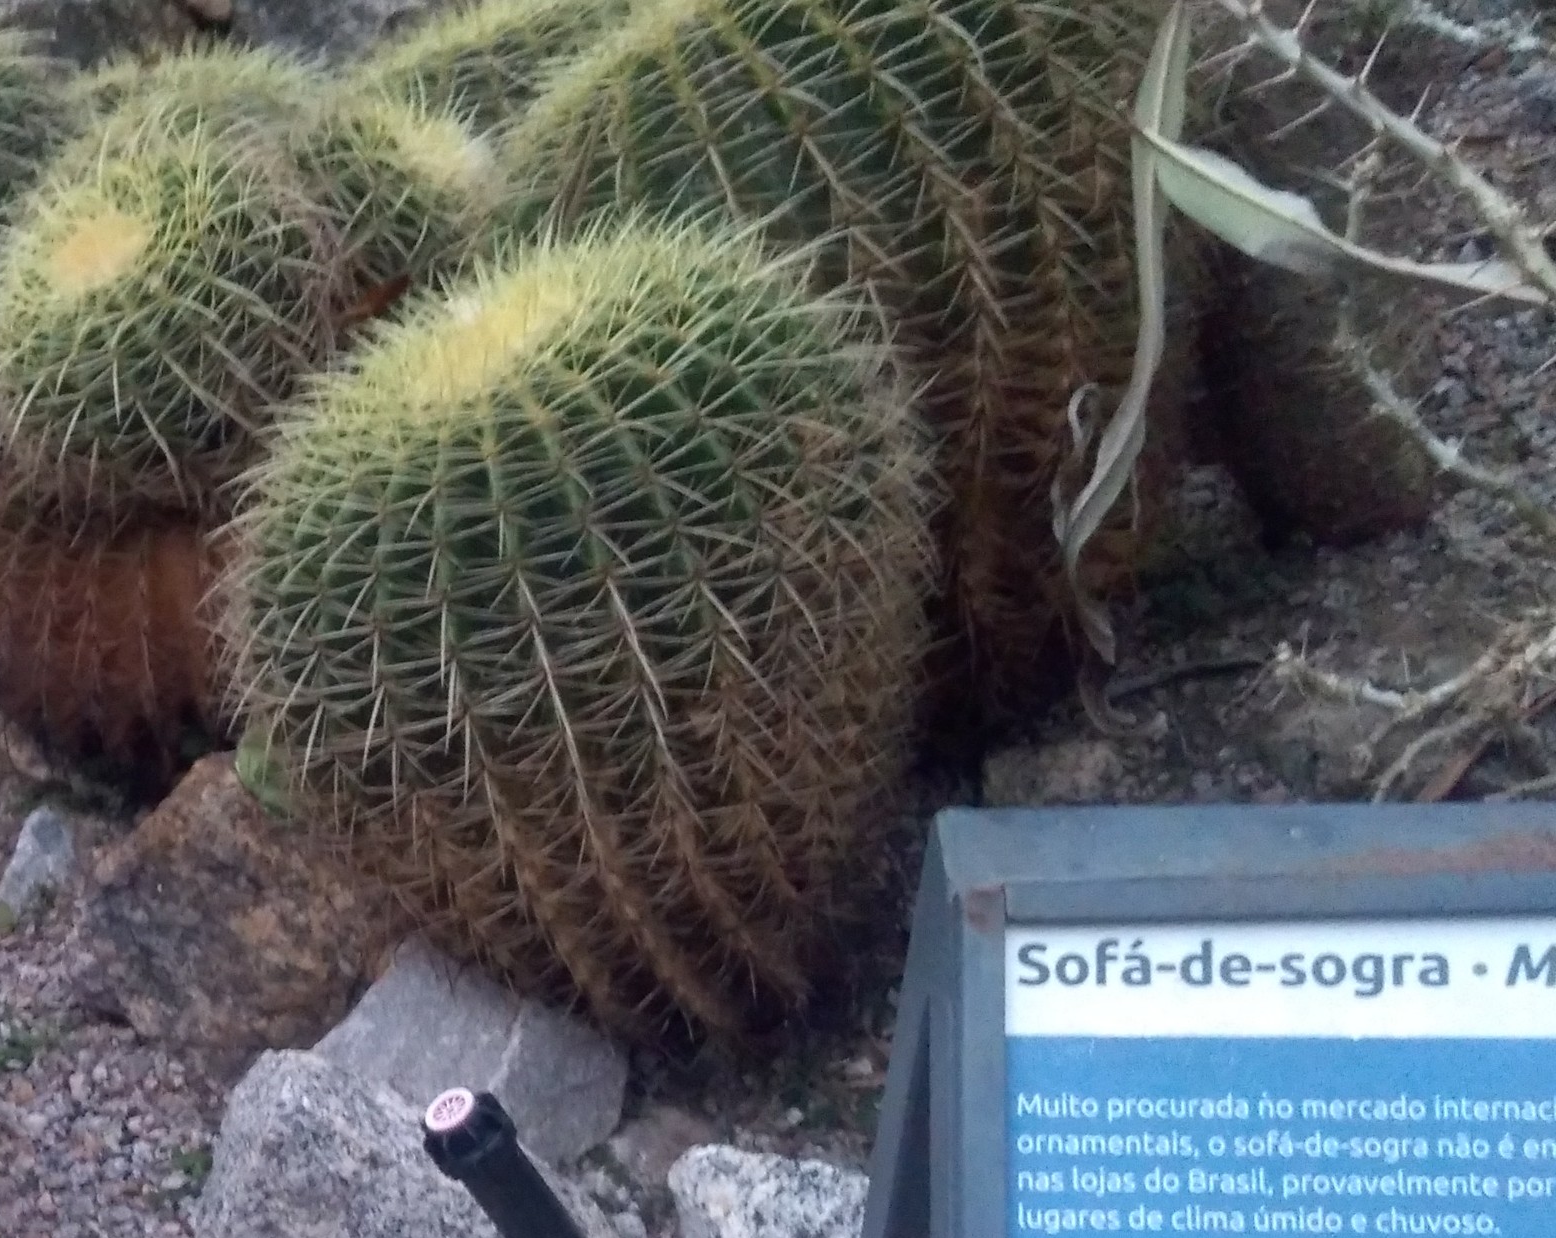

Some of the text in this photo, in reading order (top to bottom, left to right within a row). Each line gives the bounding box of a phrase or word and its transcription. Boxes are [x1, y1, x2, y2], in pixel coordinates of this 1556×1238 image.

[1016, 938, 1450, 997] Sofá-de-sogra
[1017, 1092, 1099, 1119] Muito
[1106, 1093, 1249, 1123] procurada
[1257, 1096, 1294, 1120] no
[1302, 1093, 1426, 1121] mercado
[1017, 1131, 1200, 1160] ornamentais,
[1208, 1137, 1226, 1157] o
[1233, 1130, 1429, 1164] sofá-de-sogra
[1437, 1132, 1490, 1160] não
[1497, 1133, 1515, 1160] é
[1017, 1172, 1064, 1193] nas
[1072, 1167, 1136, 1198] lojas
[1144, 1168, 1180, 1194] do
[1188, 1168, 1274, 1198] Brasil,
[1282, 1169, 1499, 1201] provavelmente
[1017, 1204, 1502, 1236] lugares de clima úmido e chuvoso.
